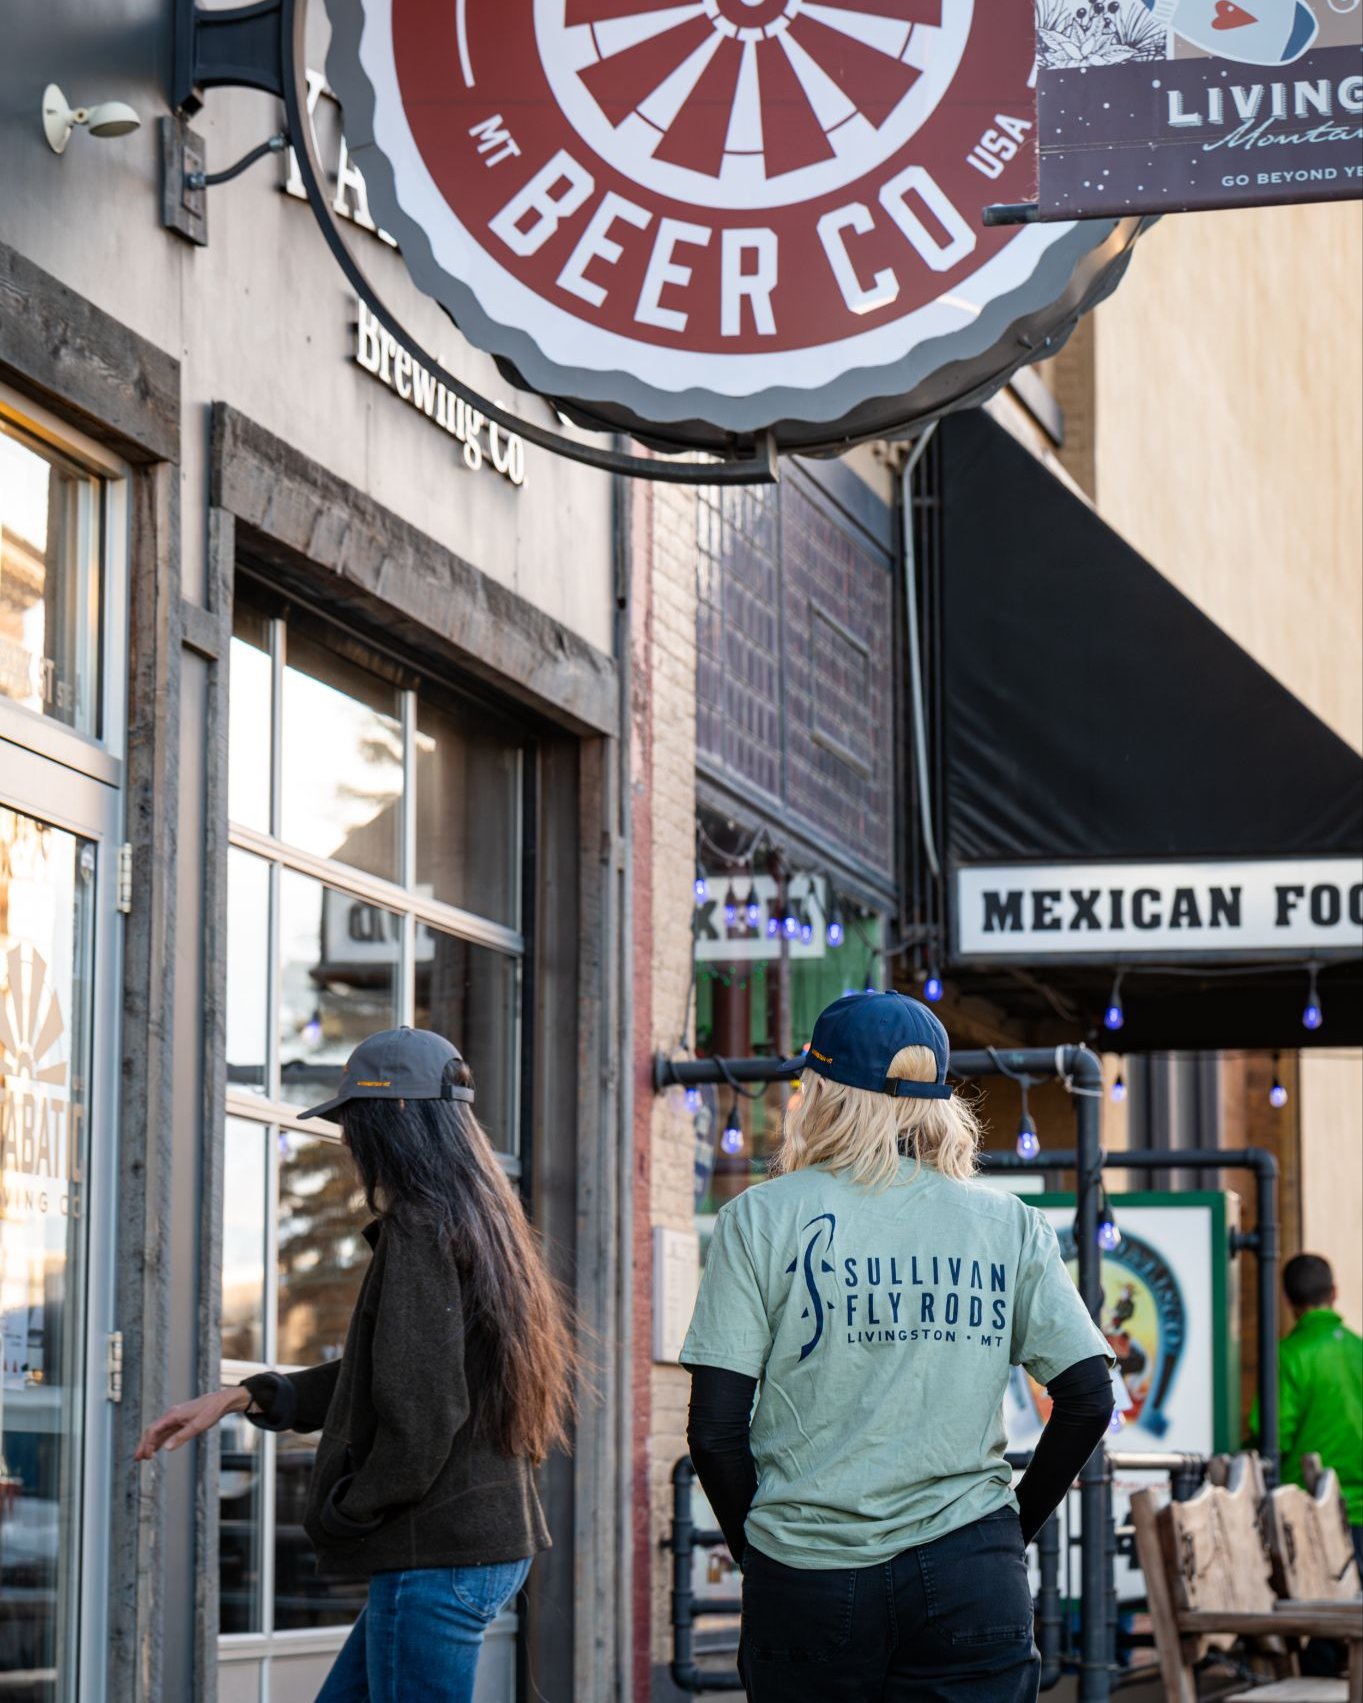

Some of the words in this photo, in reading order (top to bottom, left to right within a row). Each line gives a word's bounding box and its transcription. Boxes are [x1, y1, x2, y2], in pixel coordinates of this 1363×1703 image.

[1167, 76, 1362, 127] LIVING
[468, 114, 521, 168] MT
[966, 113, 1032, 180] USA
[1221, 175, 1249, 187] GO
[1257, 168, 1338, 184] BEYOND
[488, 148, 778, 337] BEER
[816, 165, 977, 315] CO
[357, 298, 485, 470] Brewing
[982, 886, 1242, 933] MEXICAN
[844, 1256, 1006, 1293] SULLIVAN
[847, 1292, 902, 1326] FLY
[921, 1292, 1006, 1330] RODS
[847, 1329, 956, 1343] LIVINGSTON
[980, 1334, 1003, 1348] MT
